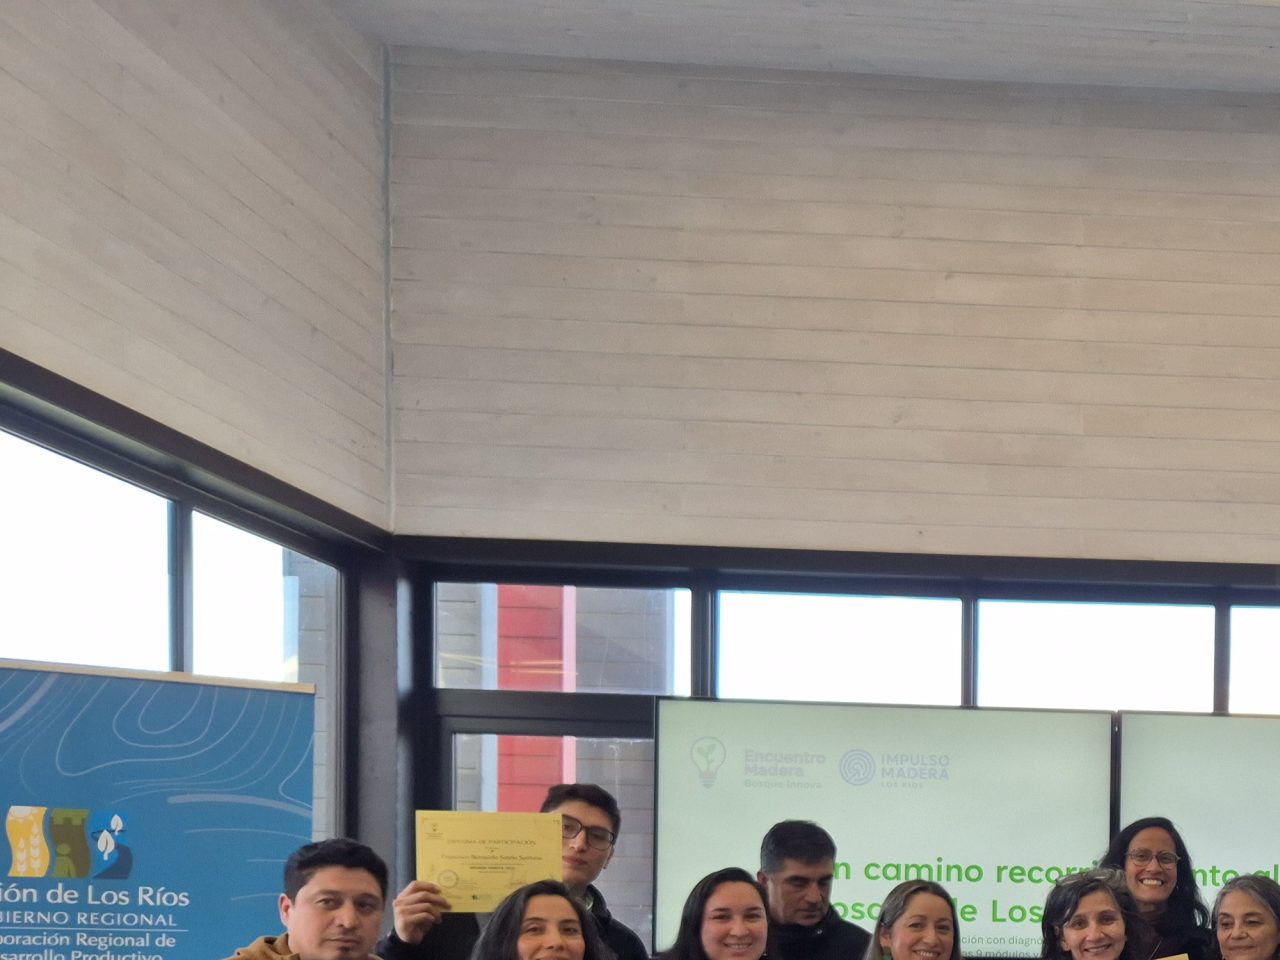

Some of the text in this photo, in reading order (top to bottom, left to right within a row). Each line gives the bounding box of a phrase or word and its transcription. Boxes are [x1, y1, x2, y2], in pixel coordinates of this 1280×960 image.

[744, 750, 827, 765] Encuentro
[881, 754, 950, 767] IMPULSO
[744, 764, 805, 777] Madera
[881, 767, 950, 780] MADERA
[864, 857, 984, 882] camino
[46, 882, 79, 904] de
[88, 885, 130, 905] Los
[138, 886, 190, 907] Ríos
[992, 900, 1044, 923] Los
[77, 912, 178, 927] REGIONAL
[76, 932, 150, 951] Regional
[155, 933, 176, 947] de
[986, 937, 1006, 945] con
